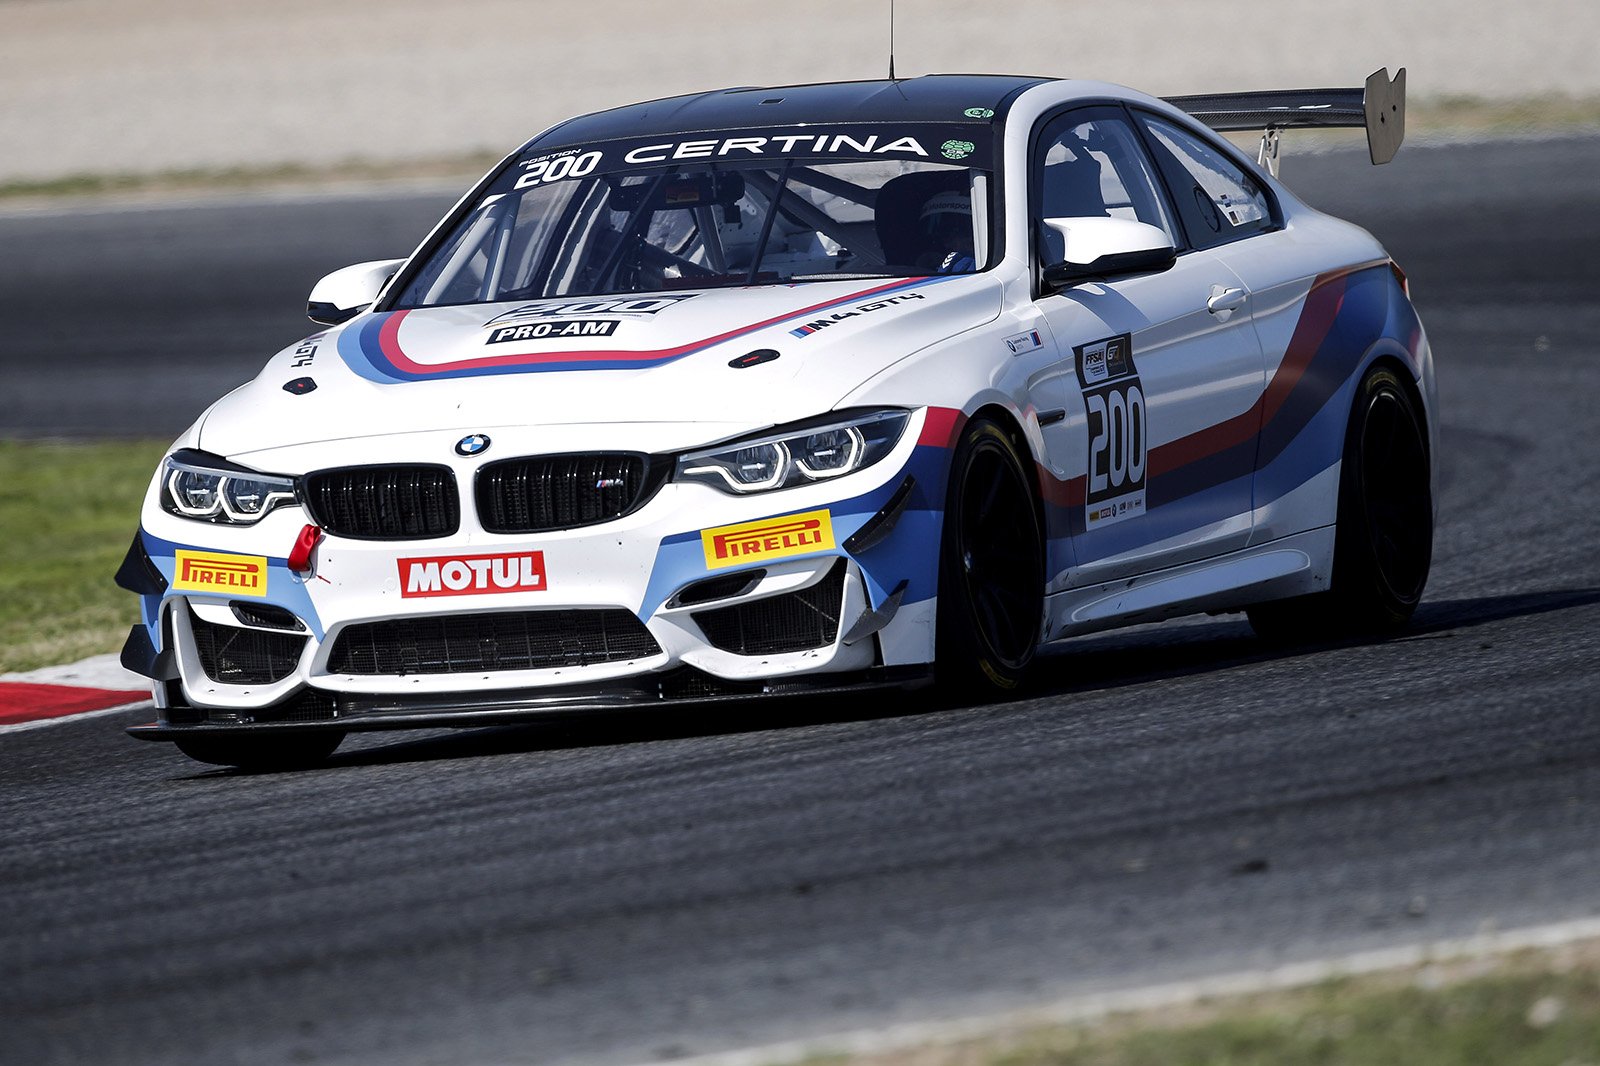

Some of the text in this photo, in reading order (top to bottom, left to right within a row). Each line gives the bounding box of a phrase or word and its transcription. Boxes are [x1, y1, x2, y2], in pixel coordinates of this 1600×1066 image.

[518, 149, 582, 168] POSITION
[624, 134, 930, 164] CERTINA
[513, 151, 603, 190] 200
[490, 299, 679, 322] 200
[804, 293, 925, 332] M4 GT4
[495, 321, 612, 341] PRO-AM
[1087, 386, 1146, 493] 200
[713, 519, 822, 559] PIRELLI
[181, 558, 259, 588] PIRELLI
[407, 557, 540, 593] MOTUL
